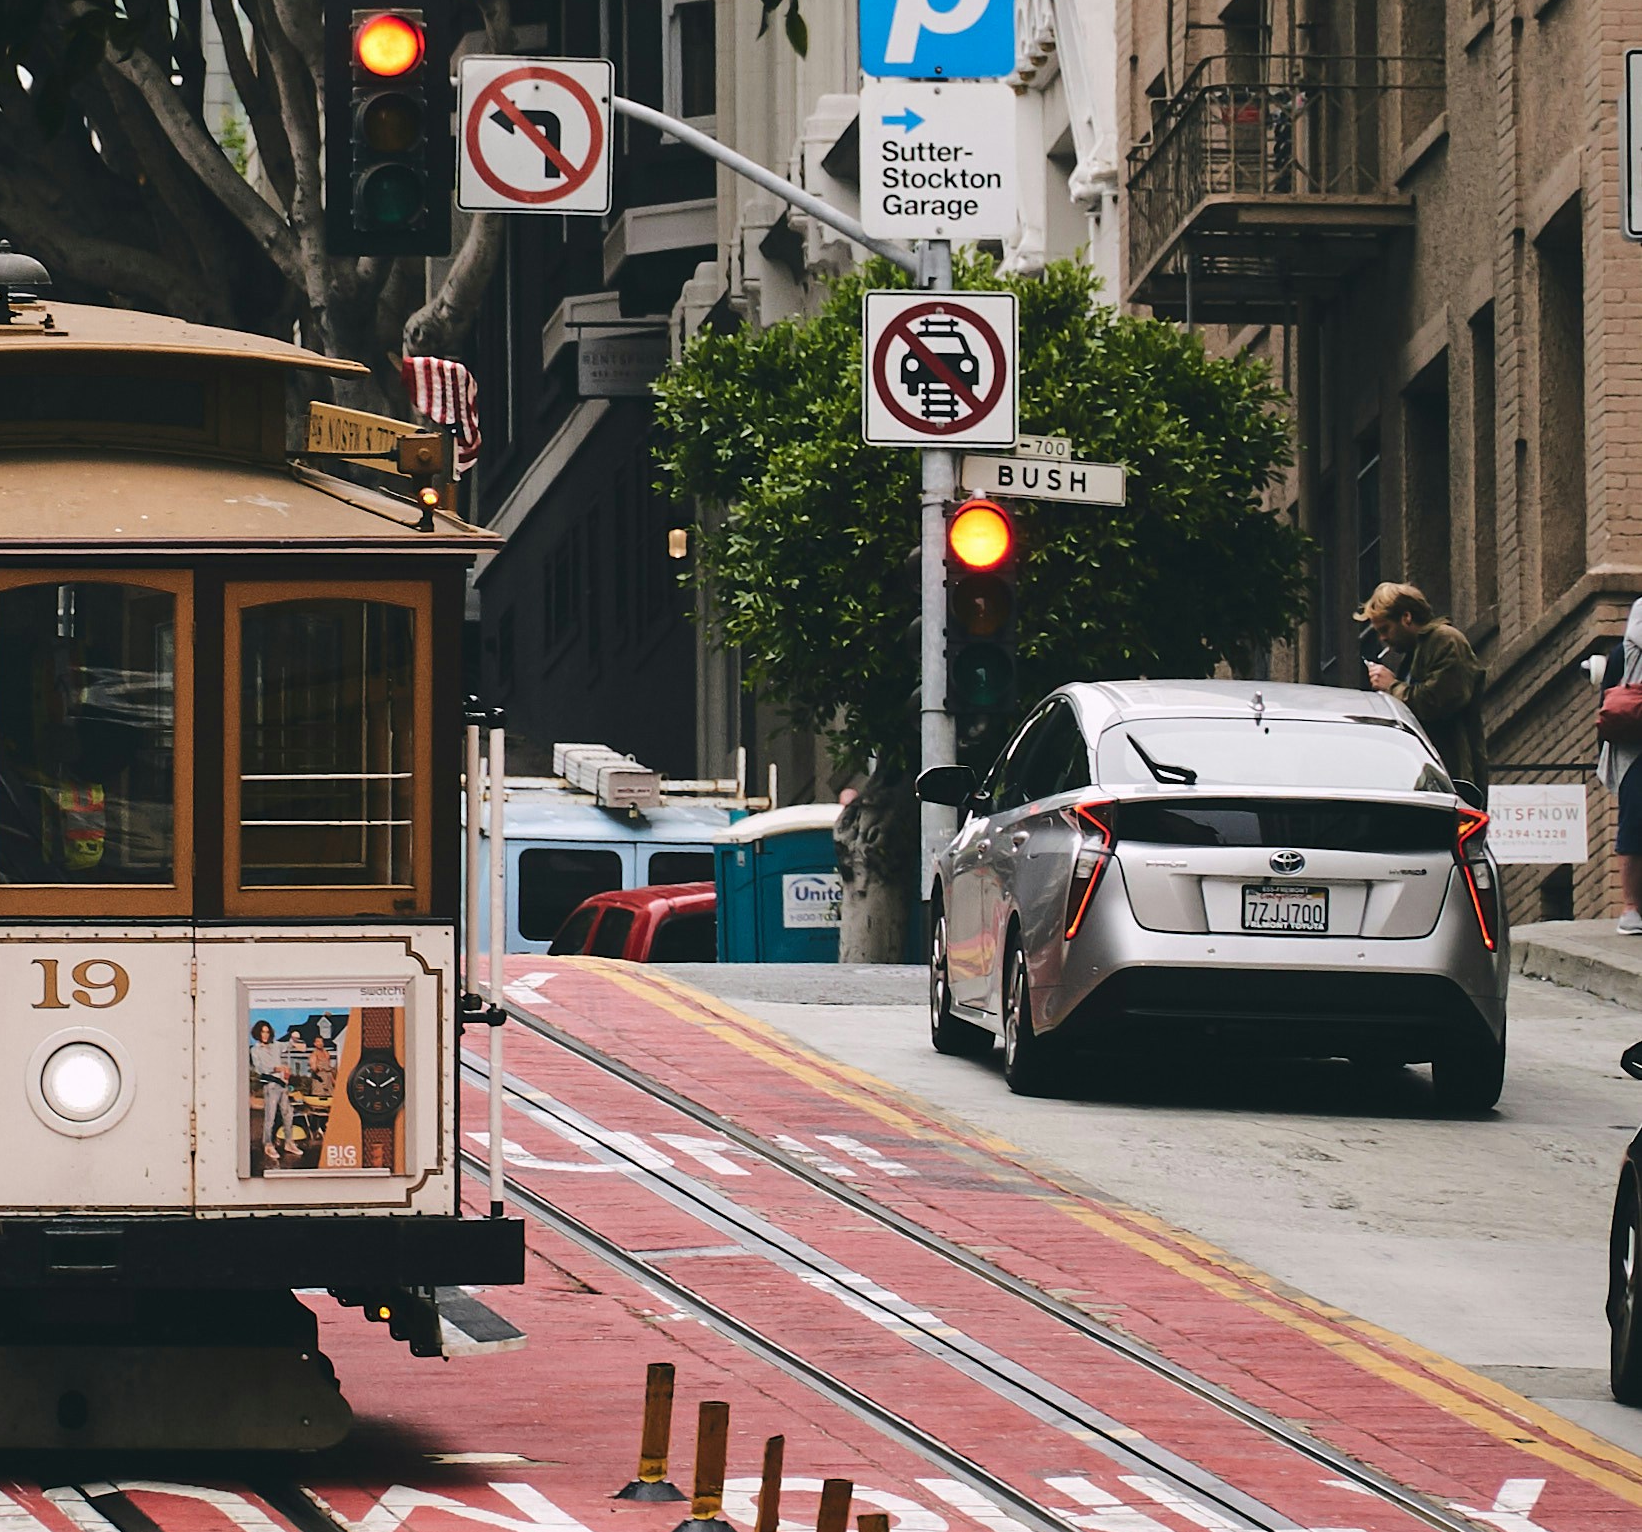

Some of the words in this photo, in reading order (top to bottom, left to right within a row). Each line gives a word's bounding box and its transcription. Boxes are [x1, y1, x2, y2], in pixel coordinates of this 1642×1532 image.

[881, 140, 973, 163] Sutter-
[881, 167, 1002, 189] Stockton
[882, 194, 979, 220] Garage
[1035, 440, 1065, 456] 700
[998, 465, 1086, 493] BUSH
[1490, 808, 1579, 821] NTSFNOW
[1488, 829, 1567, 838] 15-294-1228
[795, 885, 843, 901] Unite
[1248, 901, 1323, 924] 7ZJJ700
[31, 958, 130, 1009] 19
[326, 1145, 356, 1159] BIG
[327, 1157, 357, 1167] BOLD
[464, 1131, 921, 1177] UNI
